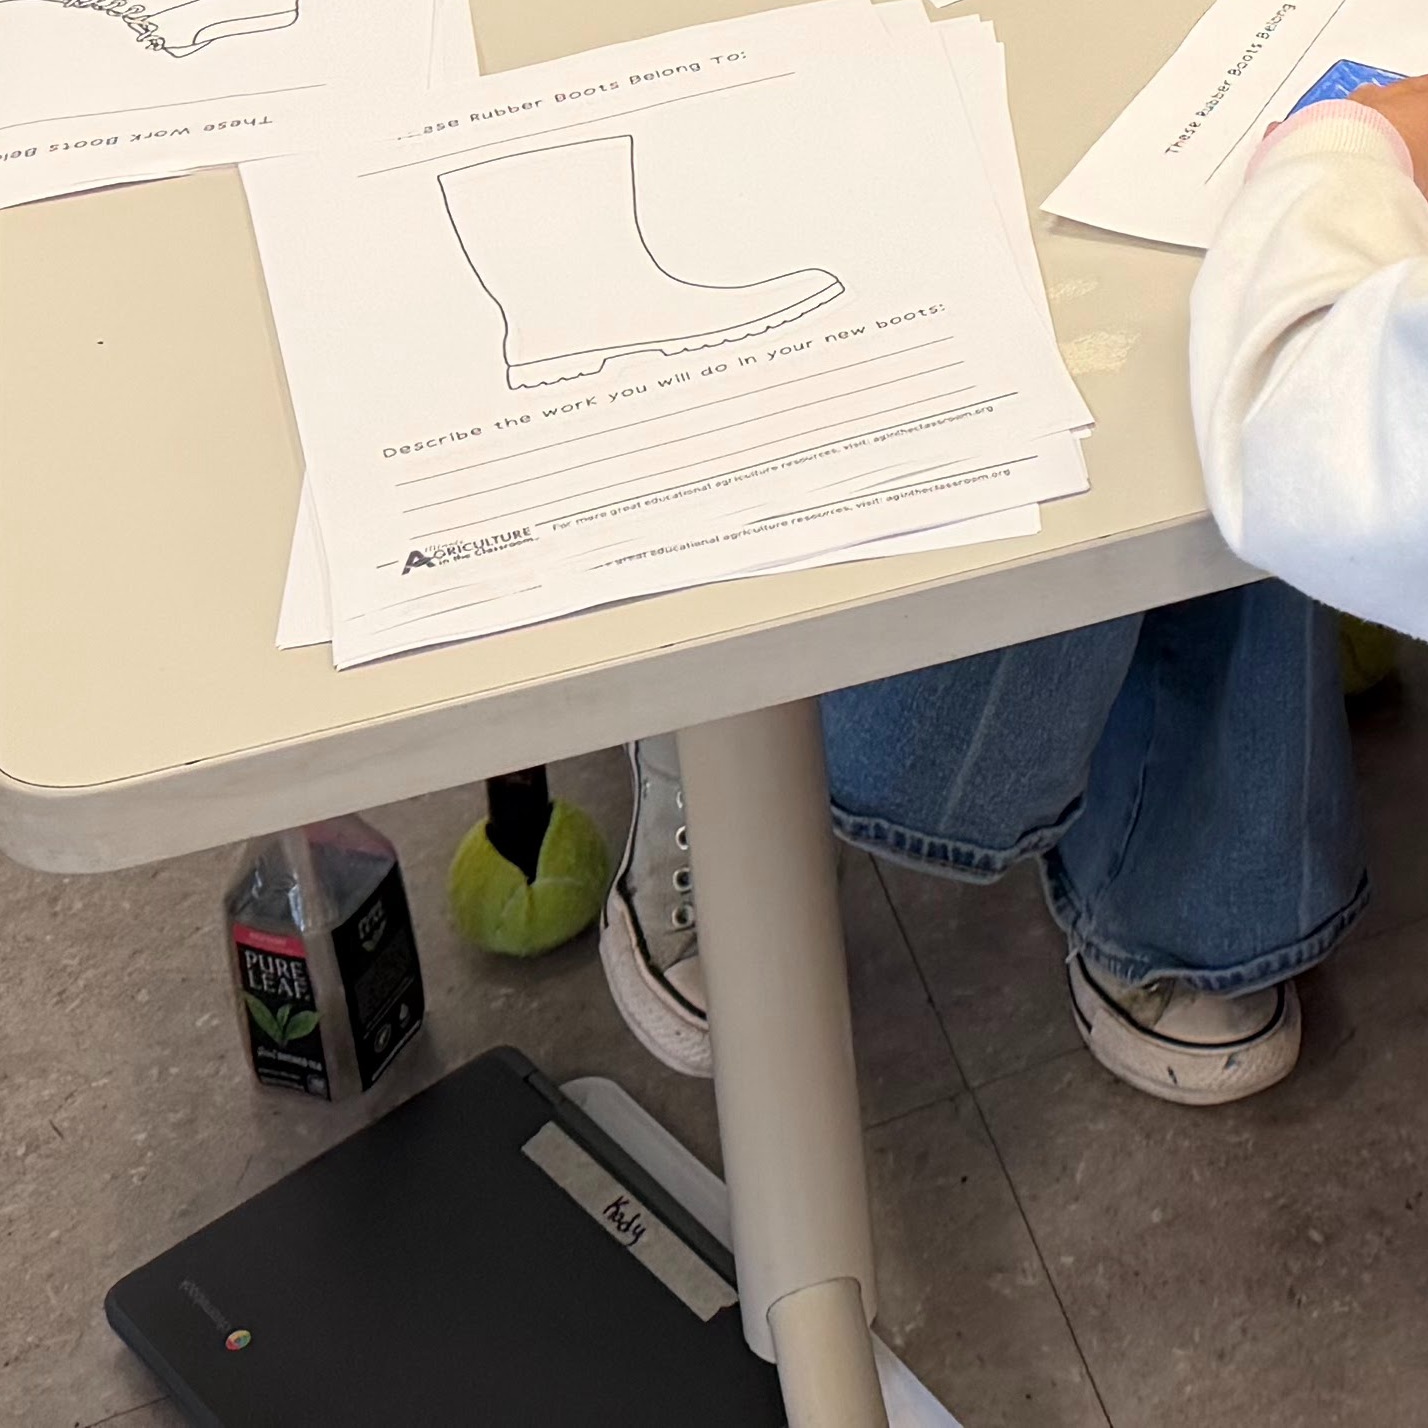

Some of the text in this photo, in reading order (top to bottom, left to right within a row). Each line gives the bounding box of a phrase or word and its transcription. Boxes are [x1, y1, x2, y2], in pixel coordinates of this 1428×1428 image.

[469, 50, 748, 124] Rubber Boots Belong To:
[1164, 120, 1202, 155] These
[1194, 78, 1233, 118] Rubber
[1226, 42, 1264, 77] Boots
[1255, 2, 1298, 40] Belong
[48, 115, 273, 153] These Work Boots
[381, 302, 948, 460] Describe the work you will do in your new boots:
[551, 521, 573, 534] For
[575, 510, 608, 525] more
[609, 501, 643, 517] great
[644, 480, 713, 508] educational
[401, 525, 533, 577] AGRICULTURE
[243, 948, 303, 980] PURE
[248, 968, 308, 1000] LEAF
